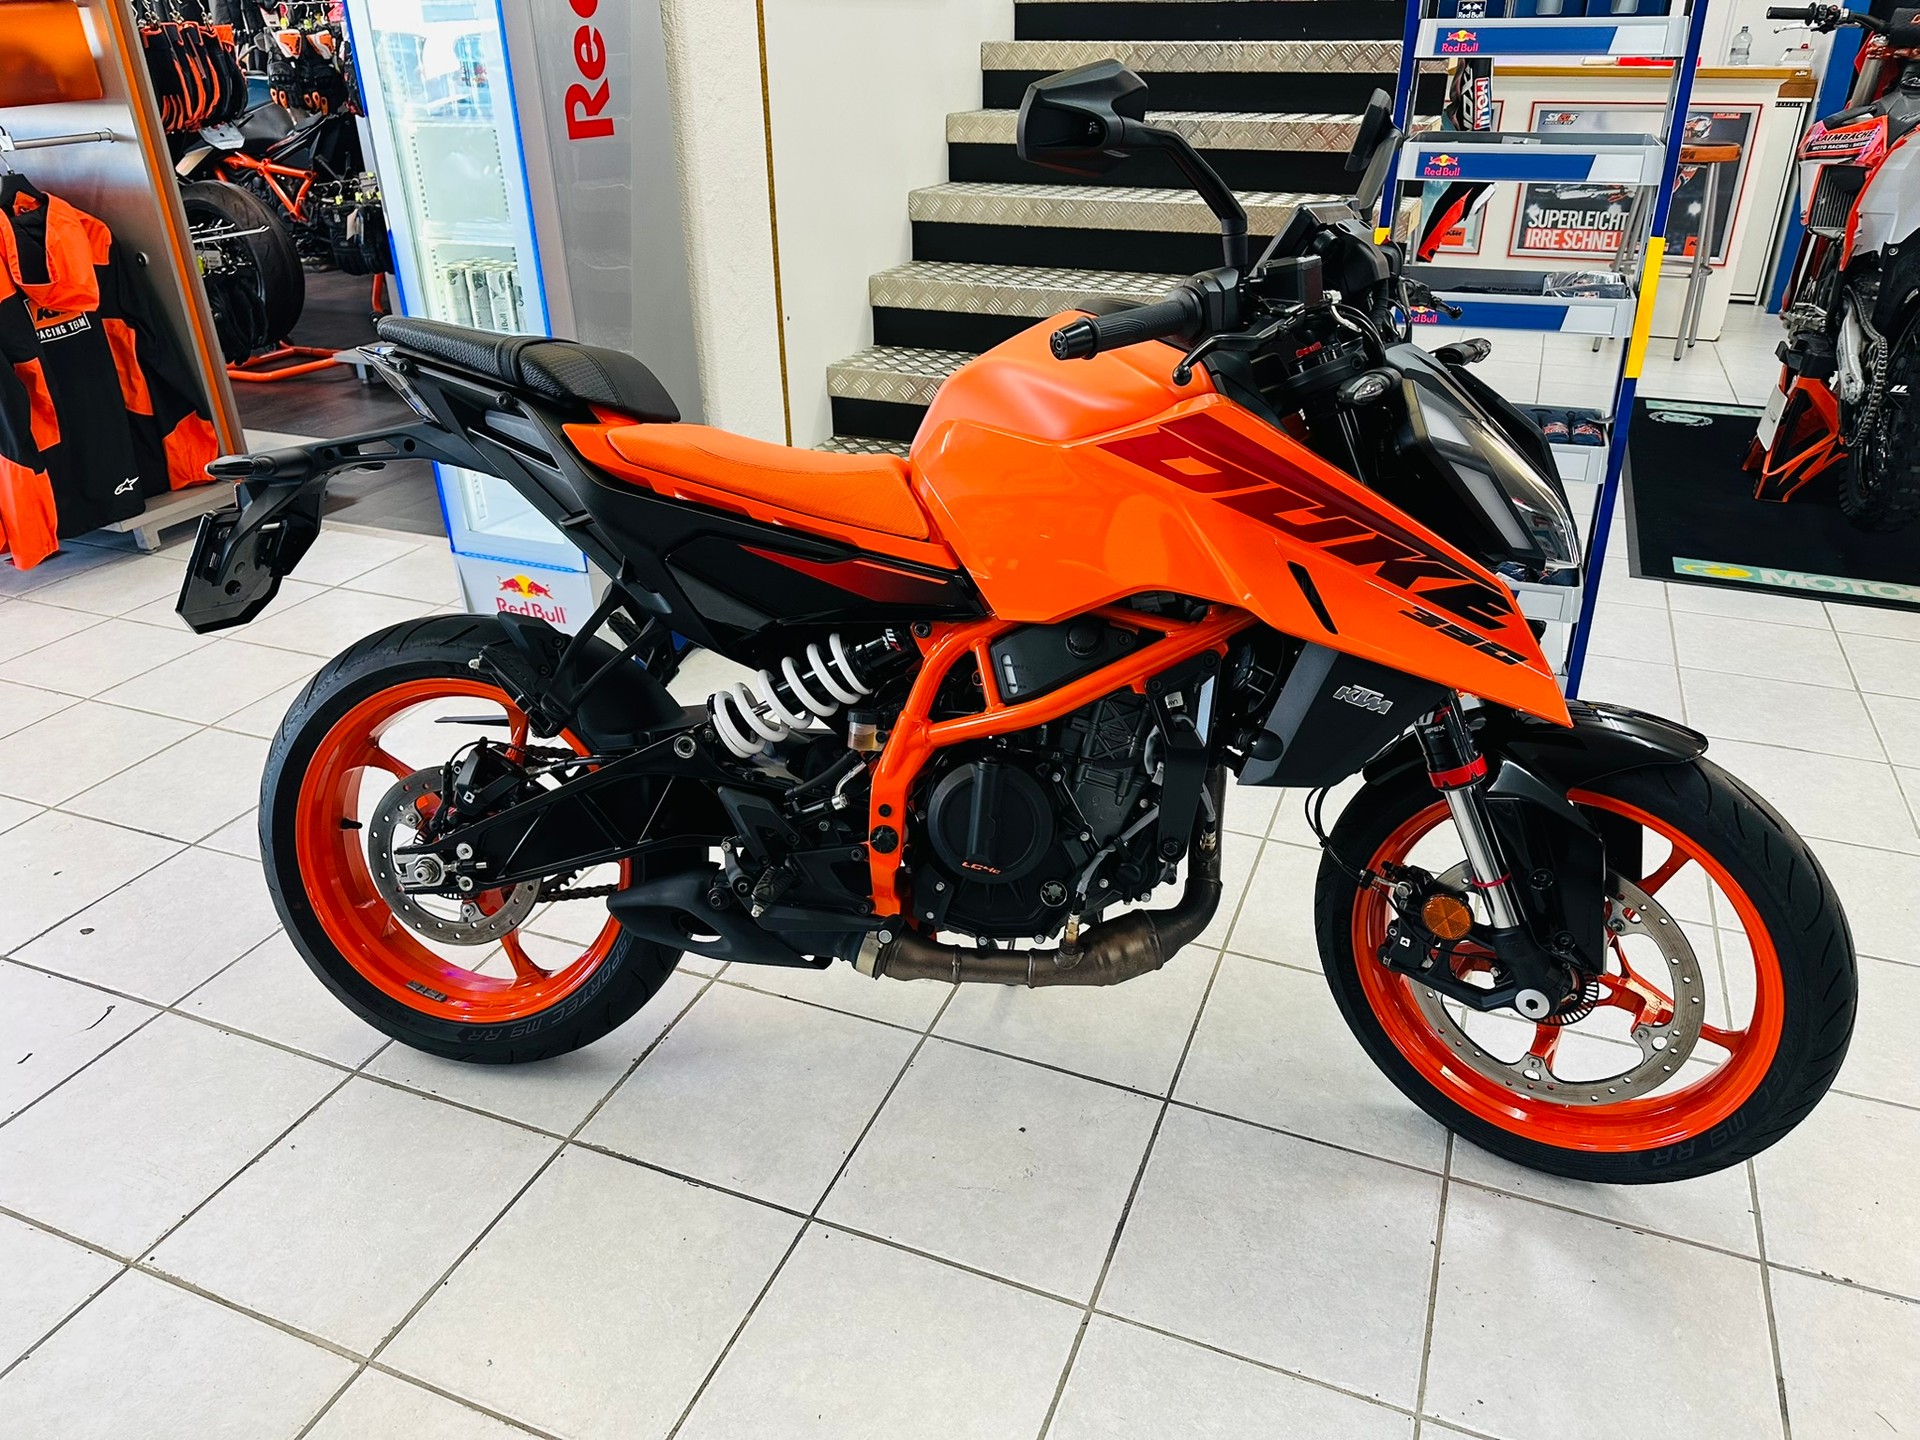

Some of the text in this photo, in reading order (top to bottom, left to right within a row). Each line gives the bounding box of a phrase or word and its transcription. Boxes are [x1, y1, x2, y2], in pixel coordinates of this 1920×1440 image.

[1441, 43, 1479, 52] Red Bull
[1424, 166, 1460, 176] Red Bull
[1528, 208, 1630, 231] SUPERLEICHT
[1524, 228, 1561, 249] IRRE
[1562, 230, 1622, 251] SCHNEL
[1420, 314, 1438, 323] Bull
[1096, 430, 1516, 631] DUKE
[496, 597, 566, 624] Red Bull
[1398, 605, 1530, 666] 390
[1332, 684, 1395, 716] KTM
[549, 936, 629, 1026] SPORTEC
